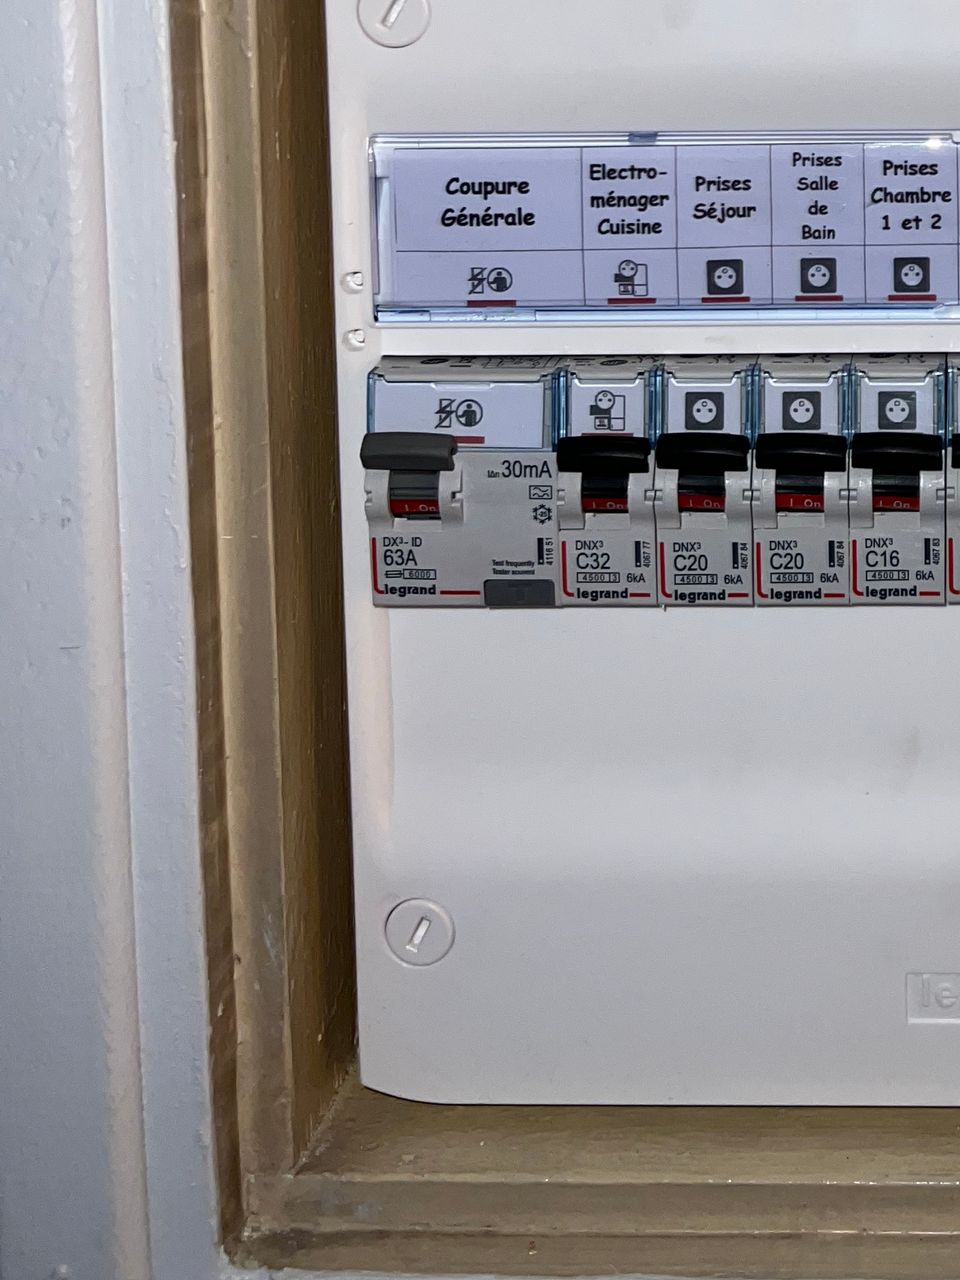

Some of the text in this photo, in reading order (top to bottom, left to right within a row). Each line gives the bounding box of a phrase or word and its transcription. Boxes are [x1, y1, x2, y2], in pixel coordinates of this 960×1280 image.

[792, 153, 842, 168] Prises
[589, 165, 668, 181] Electro-
[883, 160, 938, 177] Prises
[445, 177, 530, 200] Coupure
[695, 176, 752, 192] Prises
[797, 177, 839, 192] Salle
[590, 192, 669, 211] ménager
[871, 187, 952, 204] Chambre
[693, 203, 756, 222] Séjour
[808, 201, 828, 215] de
[441, 208, 536, 228] Générale
[882, 214, 943, 230] 1 et 2
[598, 219, 662, 235] Cuisine
[802, 225, 835, 240] Bain
[502, 460, 552, 479] 30mA
[419, 504, 437, 512] On
[804, 499, 821, 507] On
[893, 500, 910, 508] On
[411, 537, 422, 547] ID
[383, 549, 418, 566] 63A
[576, 553, 611, 570] C32
[674, 554, 708, 571] C20
[770, 553, 804, 570] C20
[866, 550, 900, 567] C16
[408, 571, 431, 579] 6000
[626, 573, 646, 583] 6kA
[724, 574, 743, 584] 6kA
[820, 573, 839, 583] 6kA
[915, 570, 935, 580] 6kA
[384, 584, 436, 597] legrand
[577, 588, 628, 602] legrand
[675, 589, 726, 603] legrand
[770, 588, 822, 602] legrand
[866, 586, 917, 599] legrand
